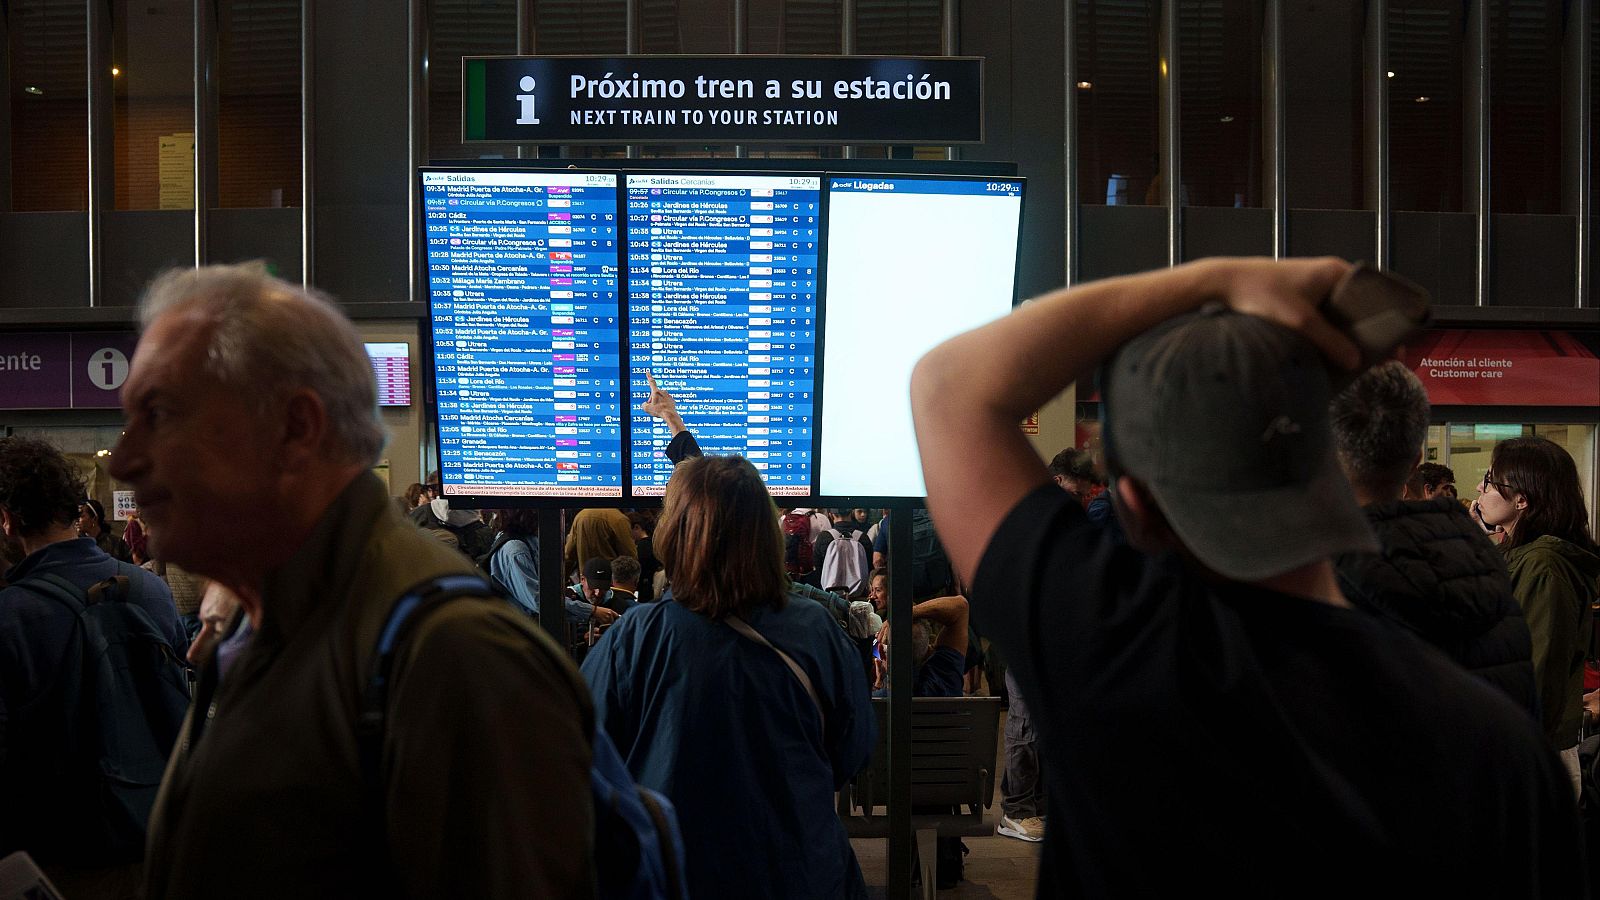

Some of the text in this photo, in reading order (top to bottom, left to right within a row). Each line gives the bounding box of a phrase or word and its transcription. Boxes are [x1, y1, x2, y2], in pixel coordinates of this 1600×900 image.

[570, 72, 950, 100] Próximo tren a su estación
[570, 110, 838, 126] NEXT TRAIN TO YOUR STATION
[447, 174, 475, 182] Salidas
[853, 180, 895, 191] Llegadas
[1420, 358, 1512, 367] Atención al cliente
[1430, 369, 1479, 378] Customer
